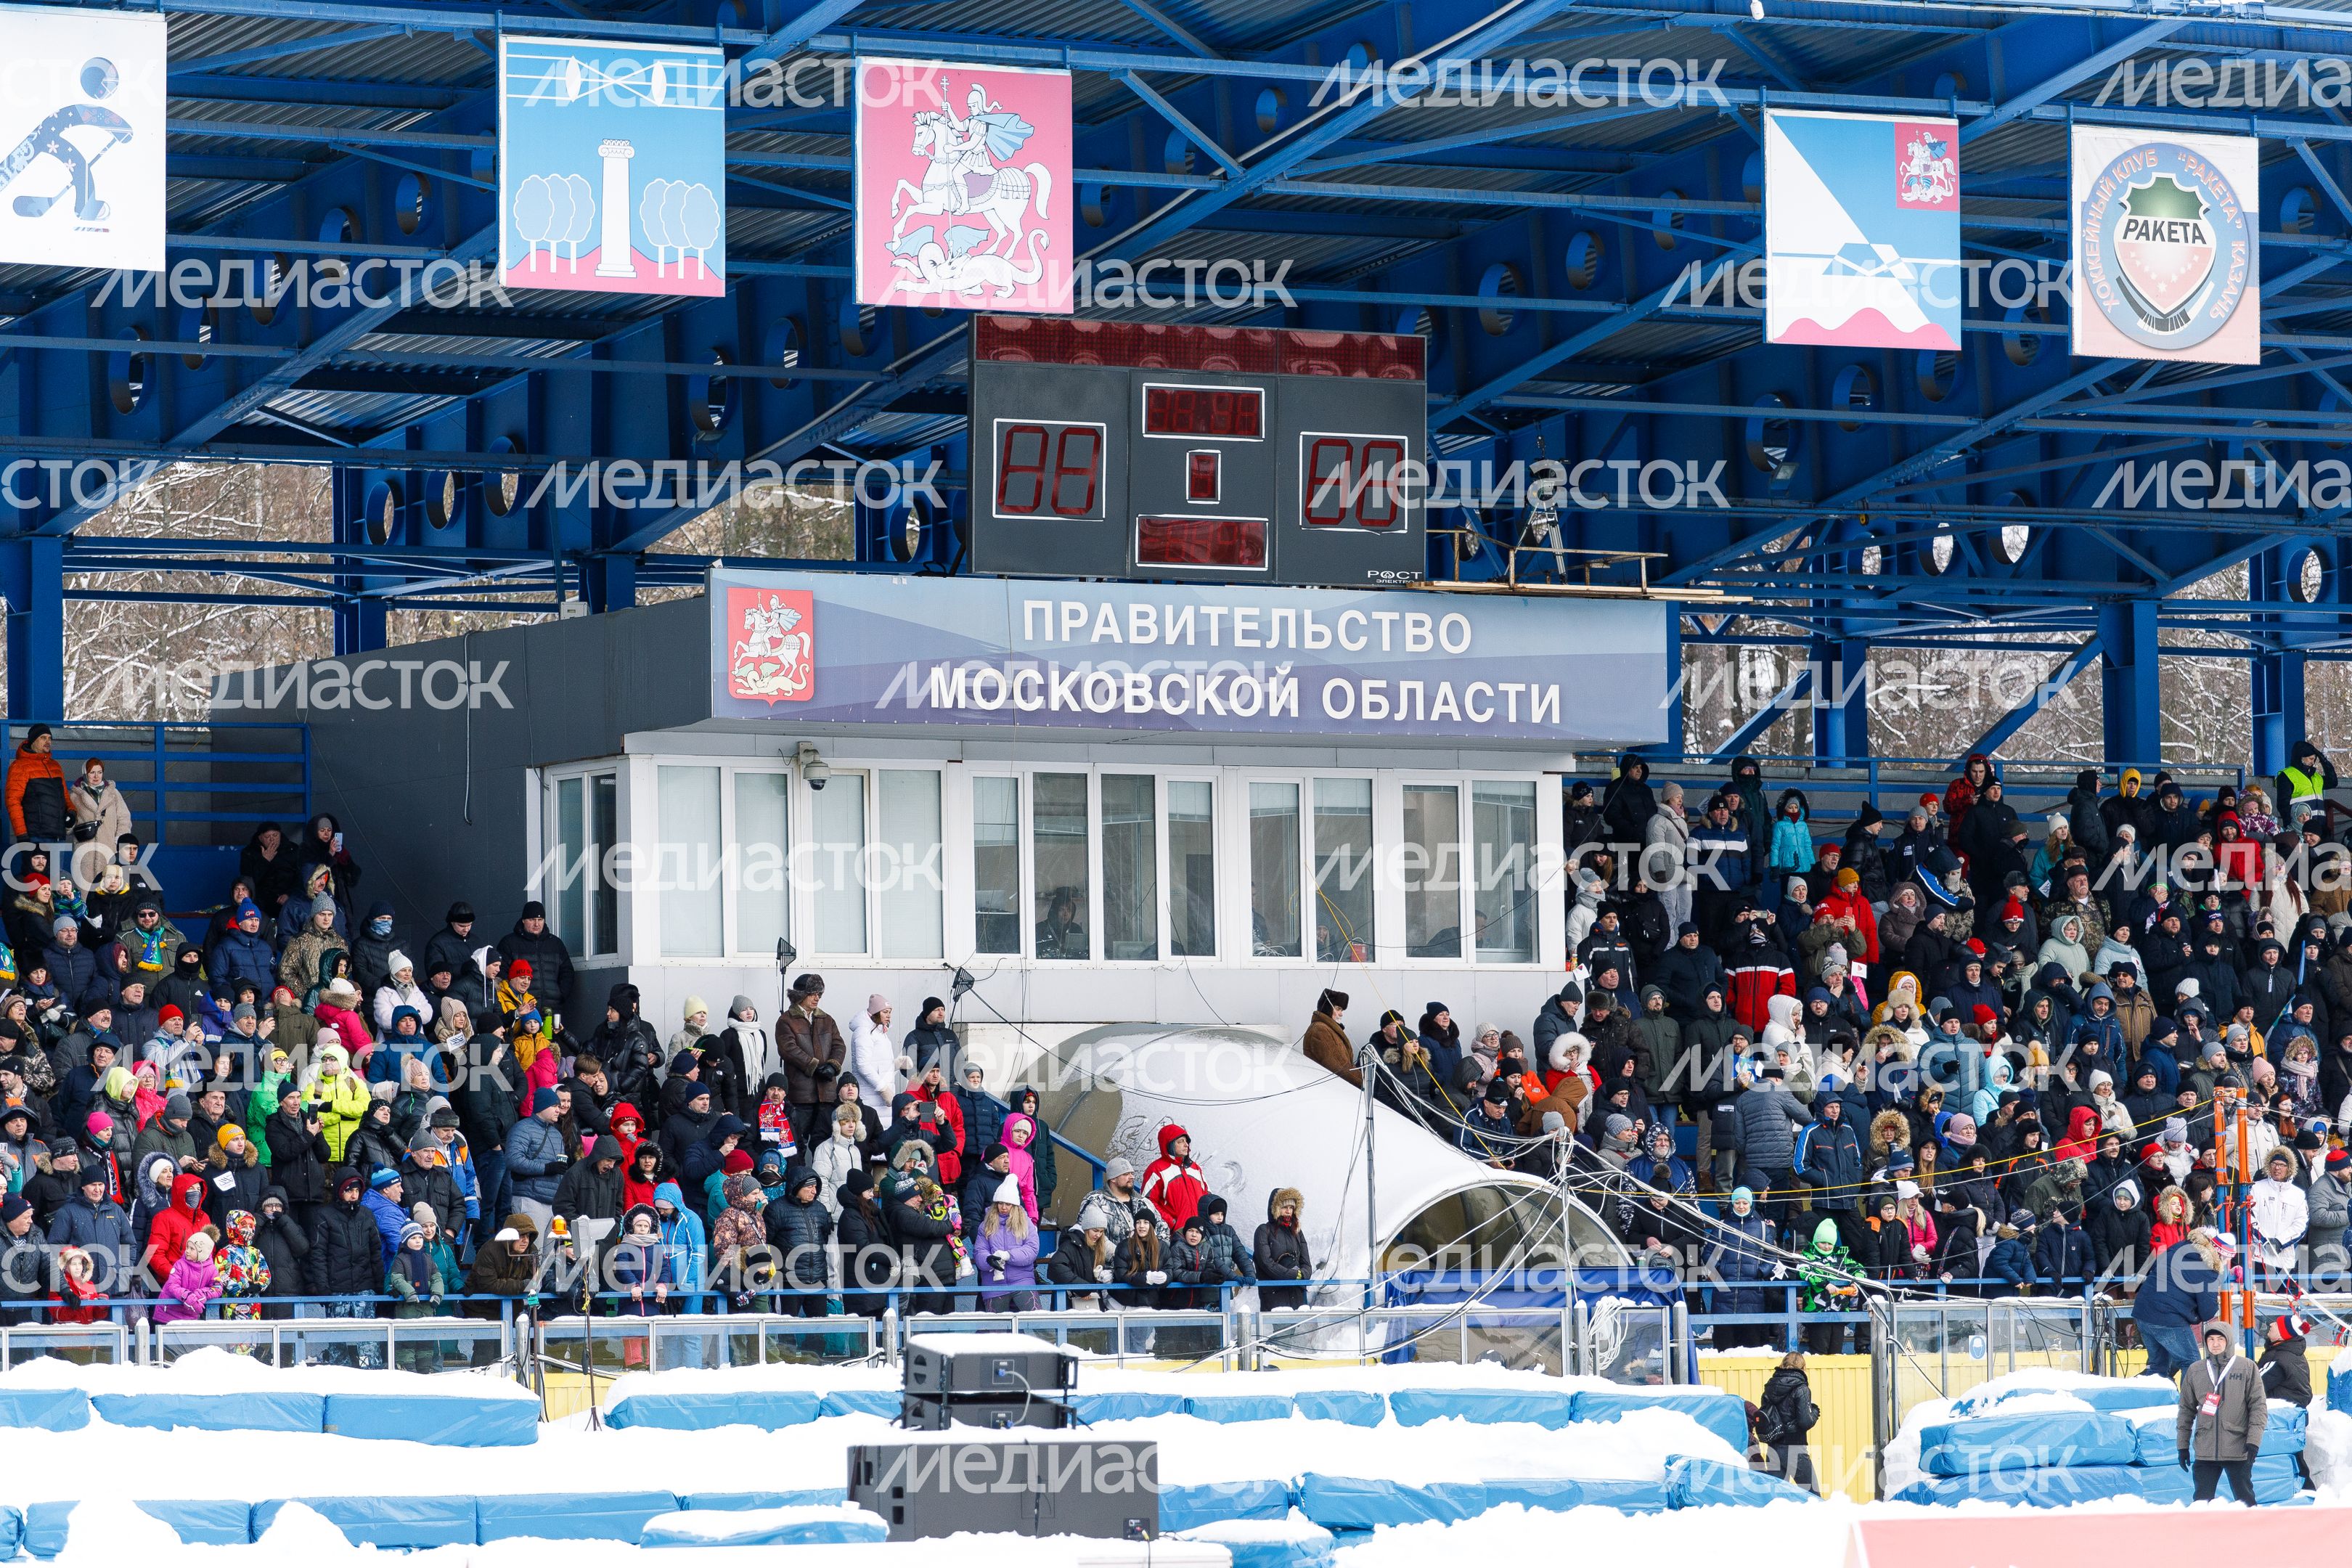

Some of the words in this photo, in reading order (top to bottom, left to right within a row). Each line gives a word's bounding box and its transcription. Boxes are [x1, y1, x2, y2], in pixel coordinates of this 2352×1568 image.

[2082, 176, 2120, 313] ХОККЕЙНЫЙ
[2112, 149, 2159, 182] КЛУБ
[2210, 240, 2245, 319] КАЗАНЬ
[2123, 219, 2207, 244] РАКЕТА
[1368, 571, 1423, 579] РОСТ
[1024, 600, 1471, 653] ПРАВИТЕЛЬСТВО
[930, 666, 1298, 717] МОСКОВСКОЙ
[1322, 678, 1560, 723] ОБЛАСТИ
